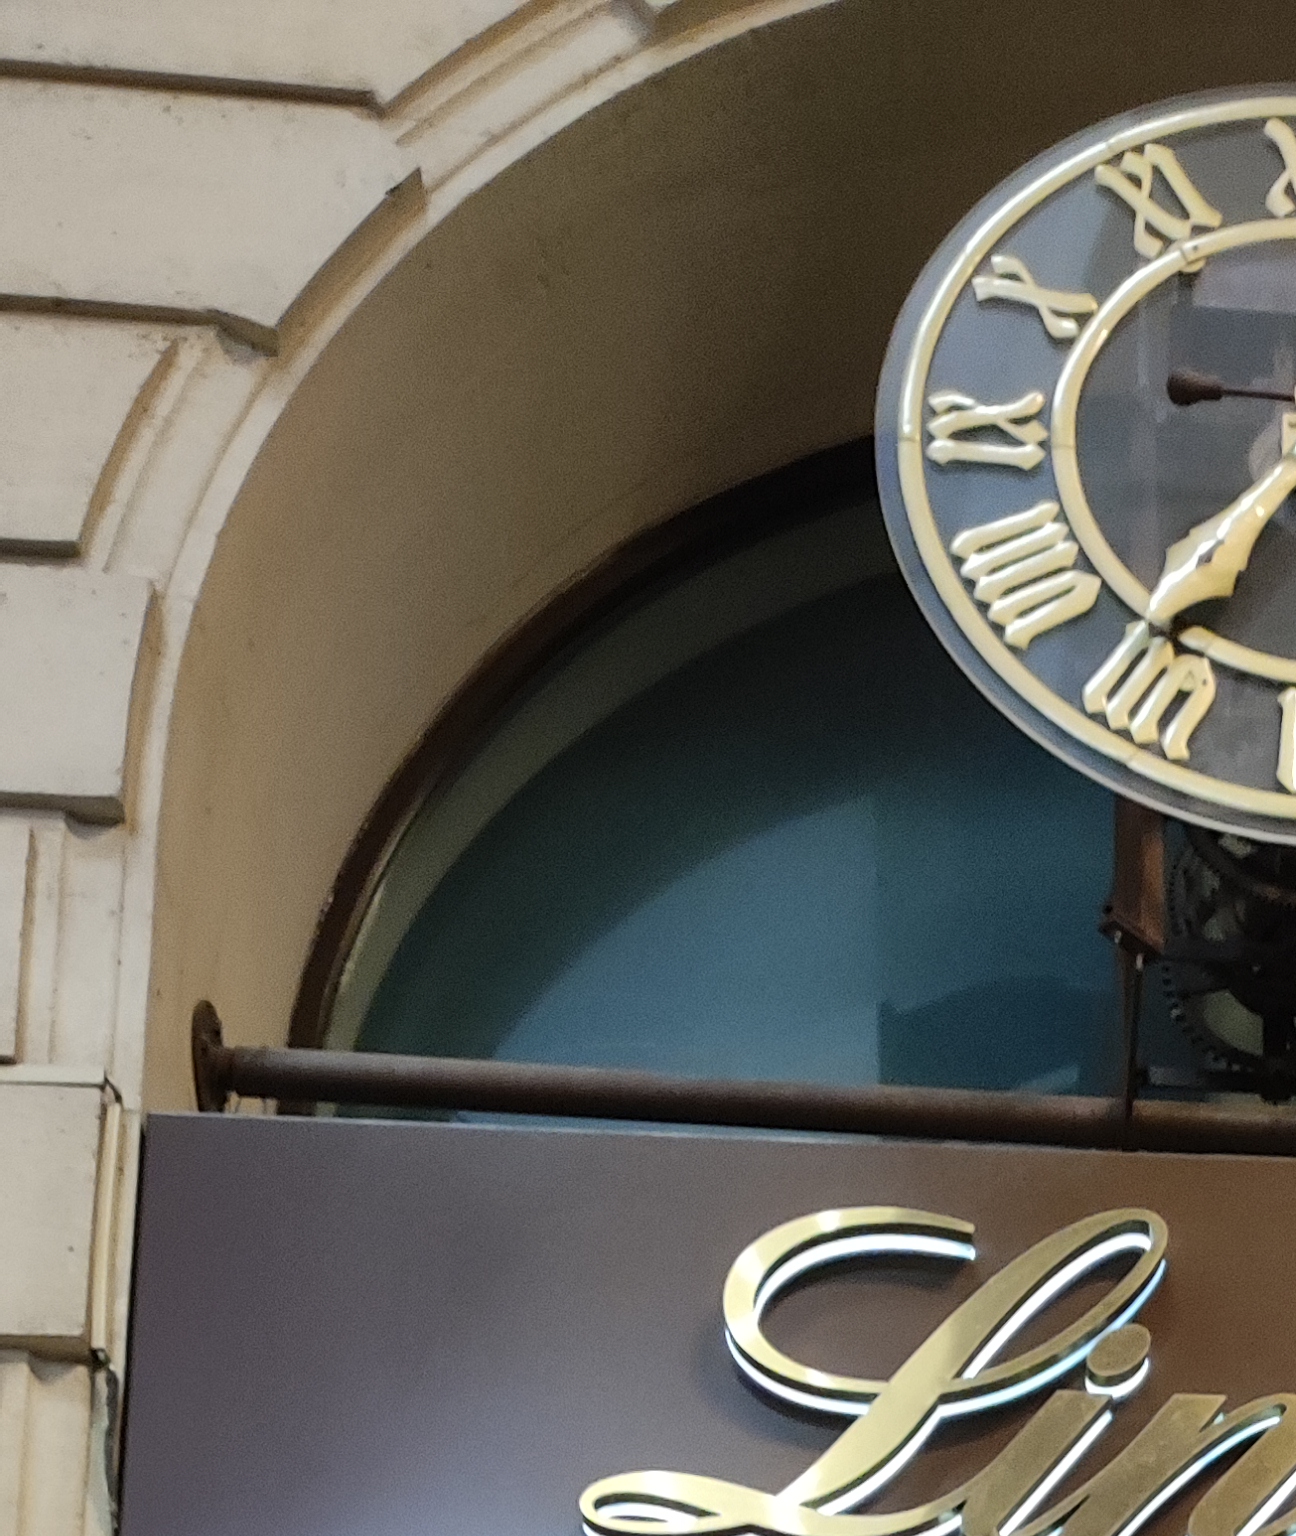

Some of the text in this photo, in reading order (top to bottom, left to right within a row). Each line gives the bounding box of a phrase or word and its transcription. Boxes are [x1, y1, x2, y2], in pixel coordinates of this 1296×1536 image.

[1093, 143, 1223, 260] XI
[971, 254, 1099, 341] X
[926, 389, 1049, 472] IX
[949, 499, 1103, 650] VIII
